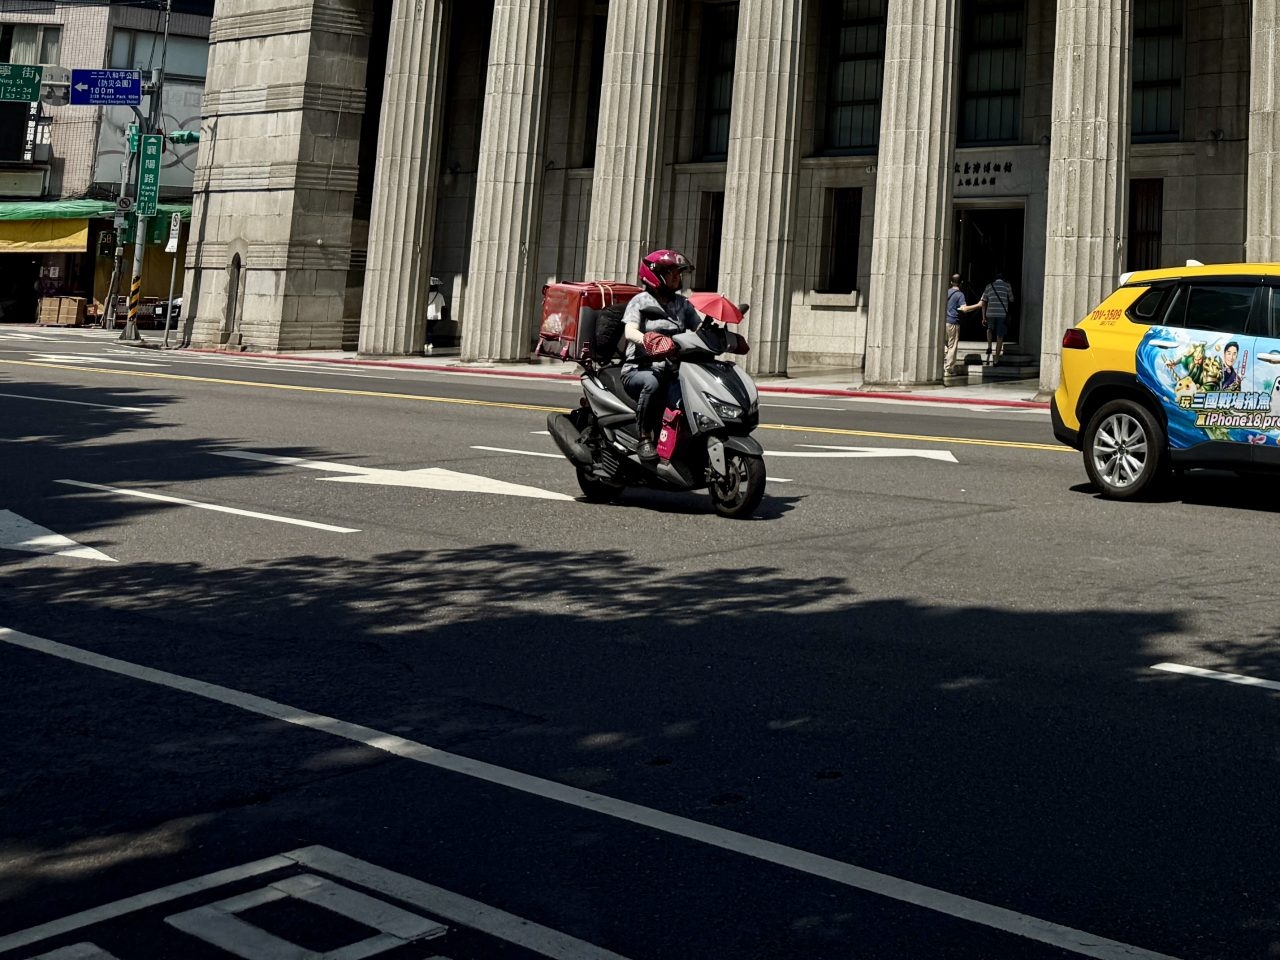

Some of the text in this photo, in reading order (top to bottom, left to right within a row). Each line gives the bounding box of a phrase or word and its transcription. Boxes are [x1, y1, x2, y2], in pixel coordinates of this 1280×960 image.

[90, 71, 139, 80] 二二八和平公園
